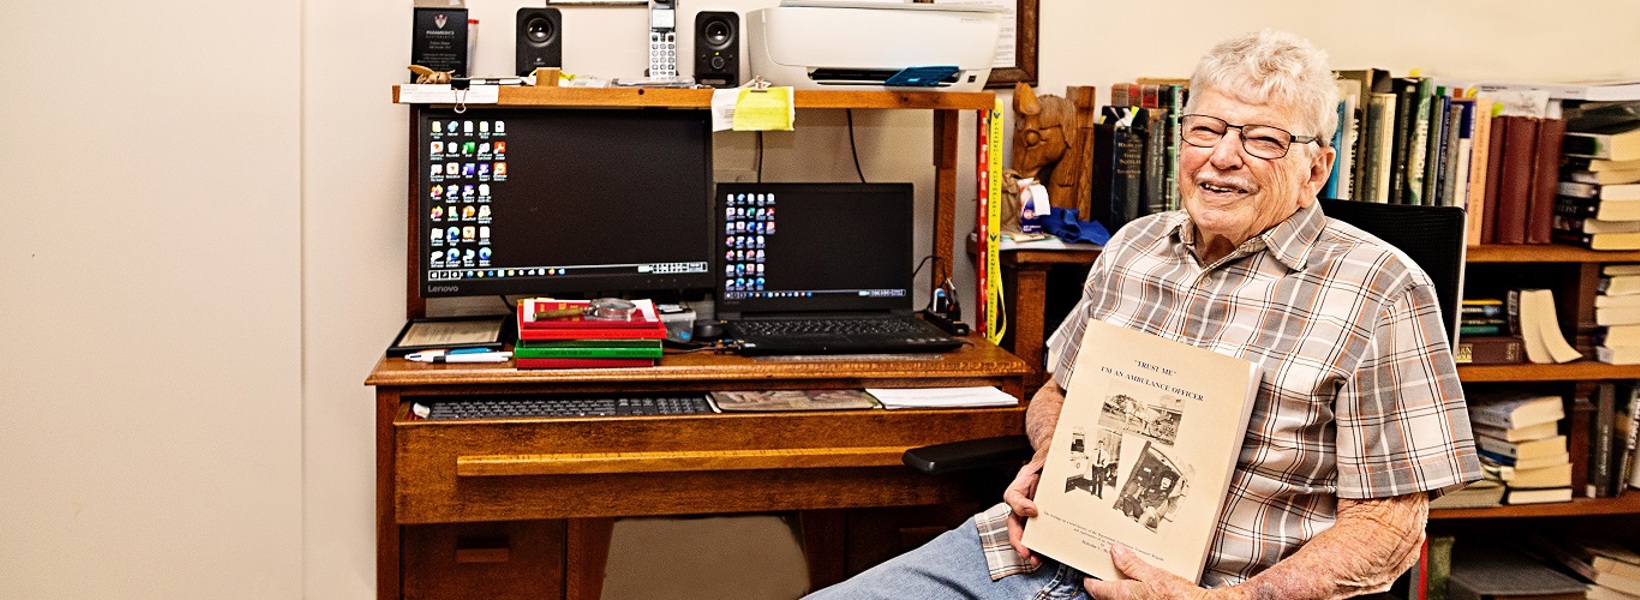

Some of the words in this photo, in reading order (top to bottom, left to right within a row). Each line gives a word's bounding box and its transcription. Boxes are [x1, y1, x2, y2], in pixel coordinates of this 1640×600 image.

[1134, 360, 1159, 372] "TRUST
[1162, 368, 1176, 376] ME"
[1125, 374, 1170, 390] AMBULANCE
[1172, 386, 1204, 400] OFFICER
